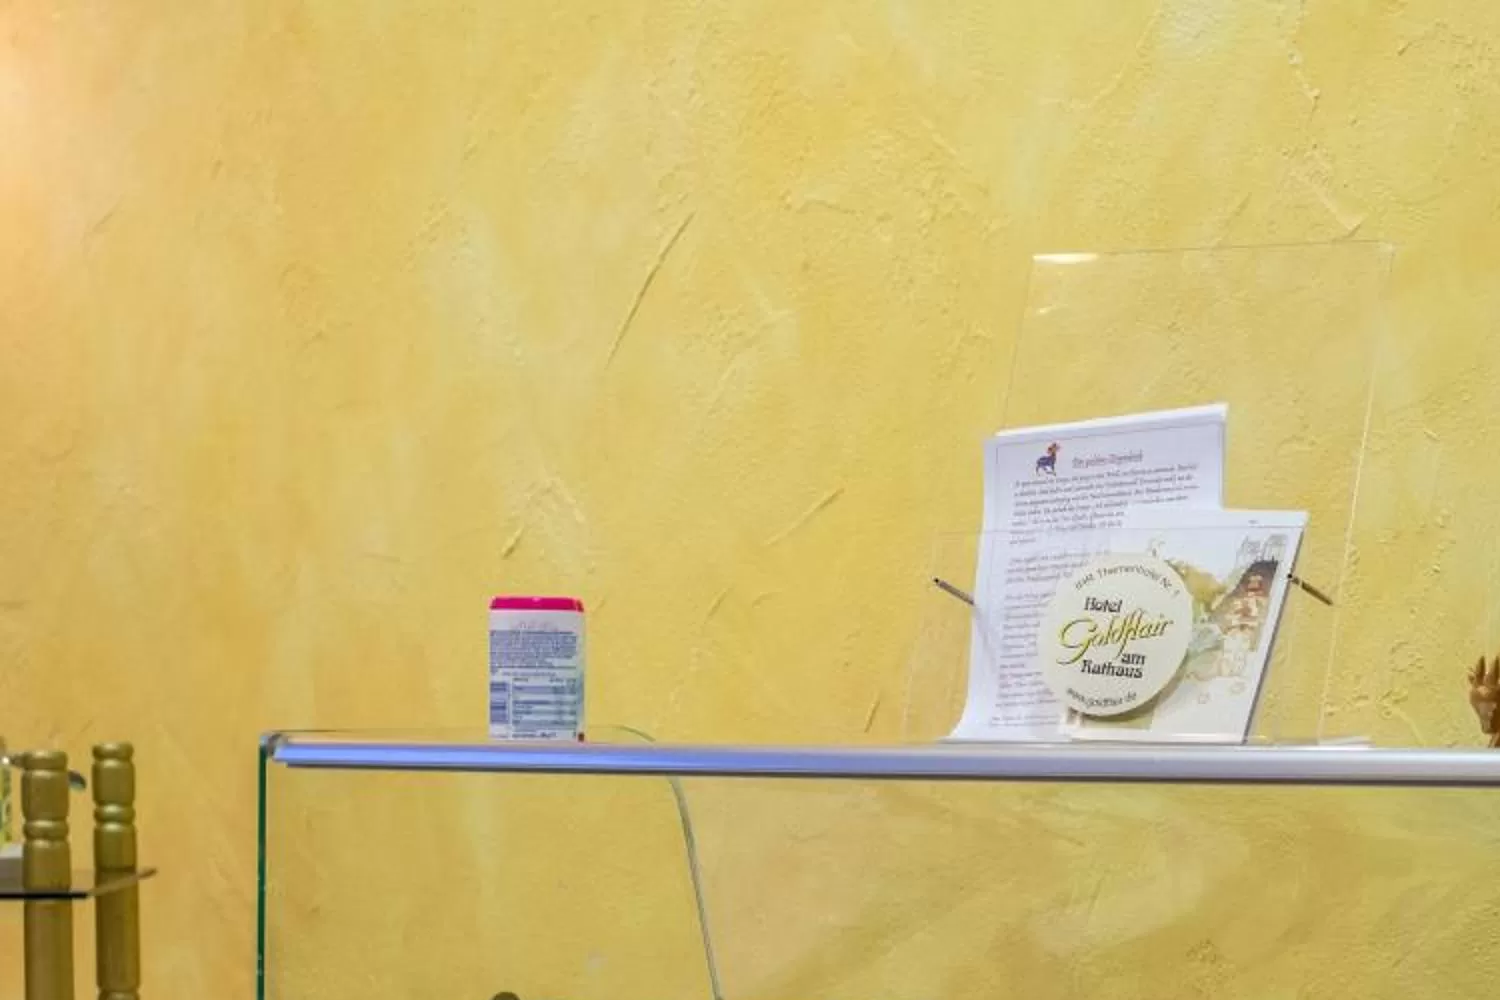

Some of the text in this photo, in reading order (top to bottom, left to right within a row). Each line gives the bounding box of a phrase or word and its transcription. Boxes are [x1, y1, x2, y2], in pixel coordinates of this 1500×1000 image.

[1084, 597, 1123, 612] Hotel
[1056, 608, 1174, 665] Goldflair
[1121, 652, 1146, 665] am
[1081, 659, 1143, 679] Rathaus
